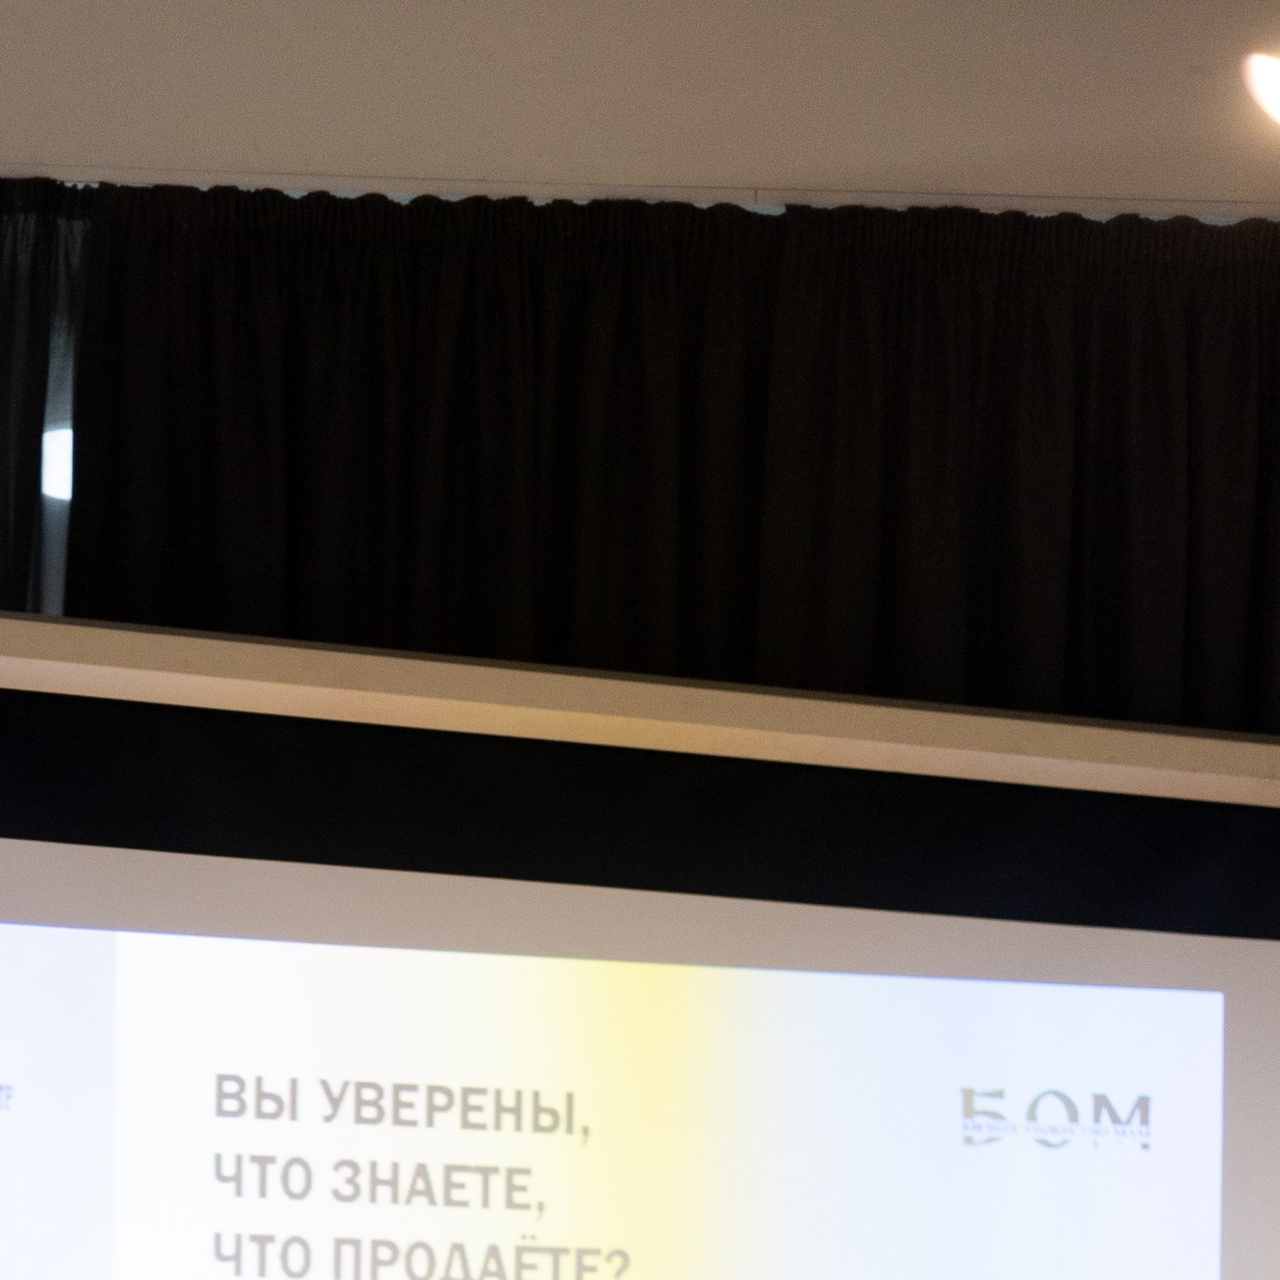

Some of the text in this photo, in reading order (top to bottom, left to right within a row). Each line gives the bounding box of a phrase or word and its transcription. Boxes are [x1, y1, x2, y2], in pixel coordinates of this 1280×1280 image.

[215, 1074, 590, 1144] ВЫ УВЕРЕНЫ,
[214, 1153, 545, 1219] ЧТО ЗНАЕТЕ,
[214, 1232, 312, 1278] ЧТО
